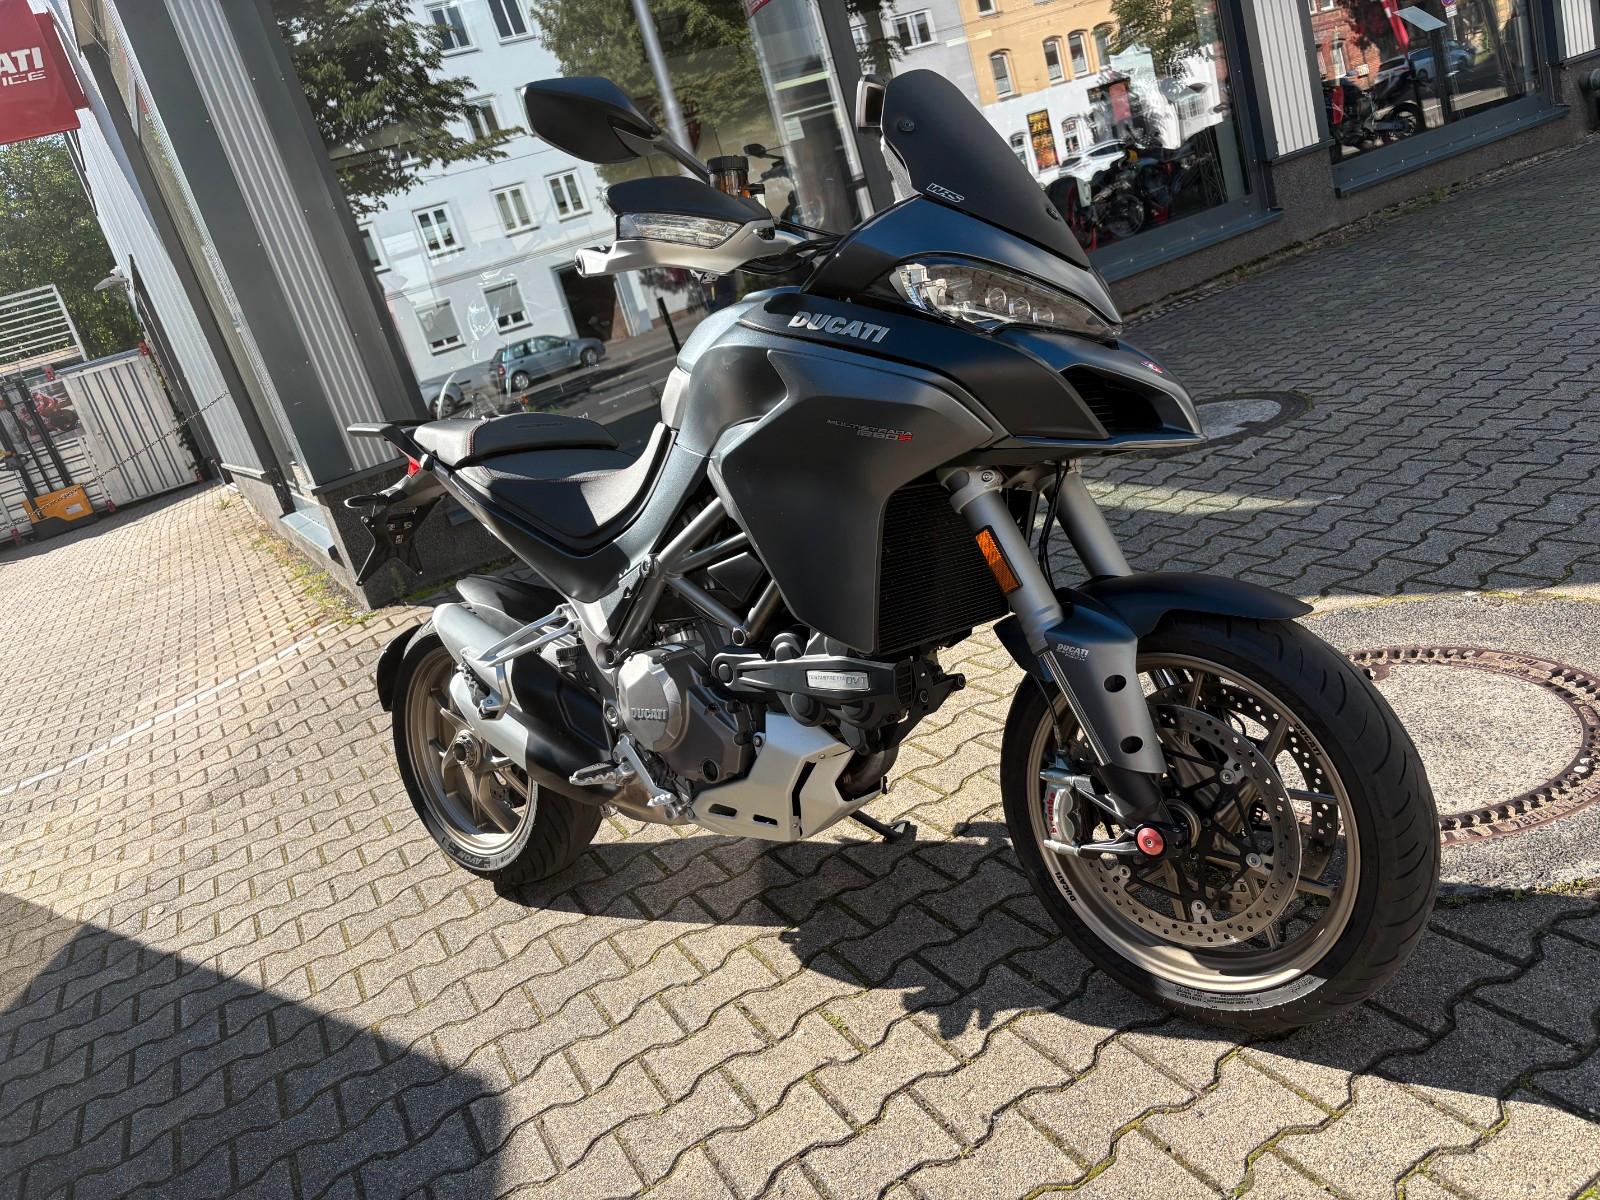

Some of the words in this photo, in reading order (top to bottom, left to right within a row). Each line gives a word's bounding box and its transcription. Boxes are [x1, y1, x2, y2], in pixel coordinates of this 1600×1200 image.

[787, 311, 891, 343] DUCATI
[826, 419, 913, 436] MULTISTRADA
[1057, 643, 1089, 657] DUCATI
[631, 707, 668, 720] DUCATI
[1294, 723, 1322, 756] DUCATI
[1046, 792, 1057, 834] brembo
[1054, 871, 1077, 902] DUCATI
